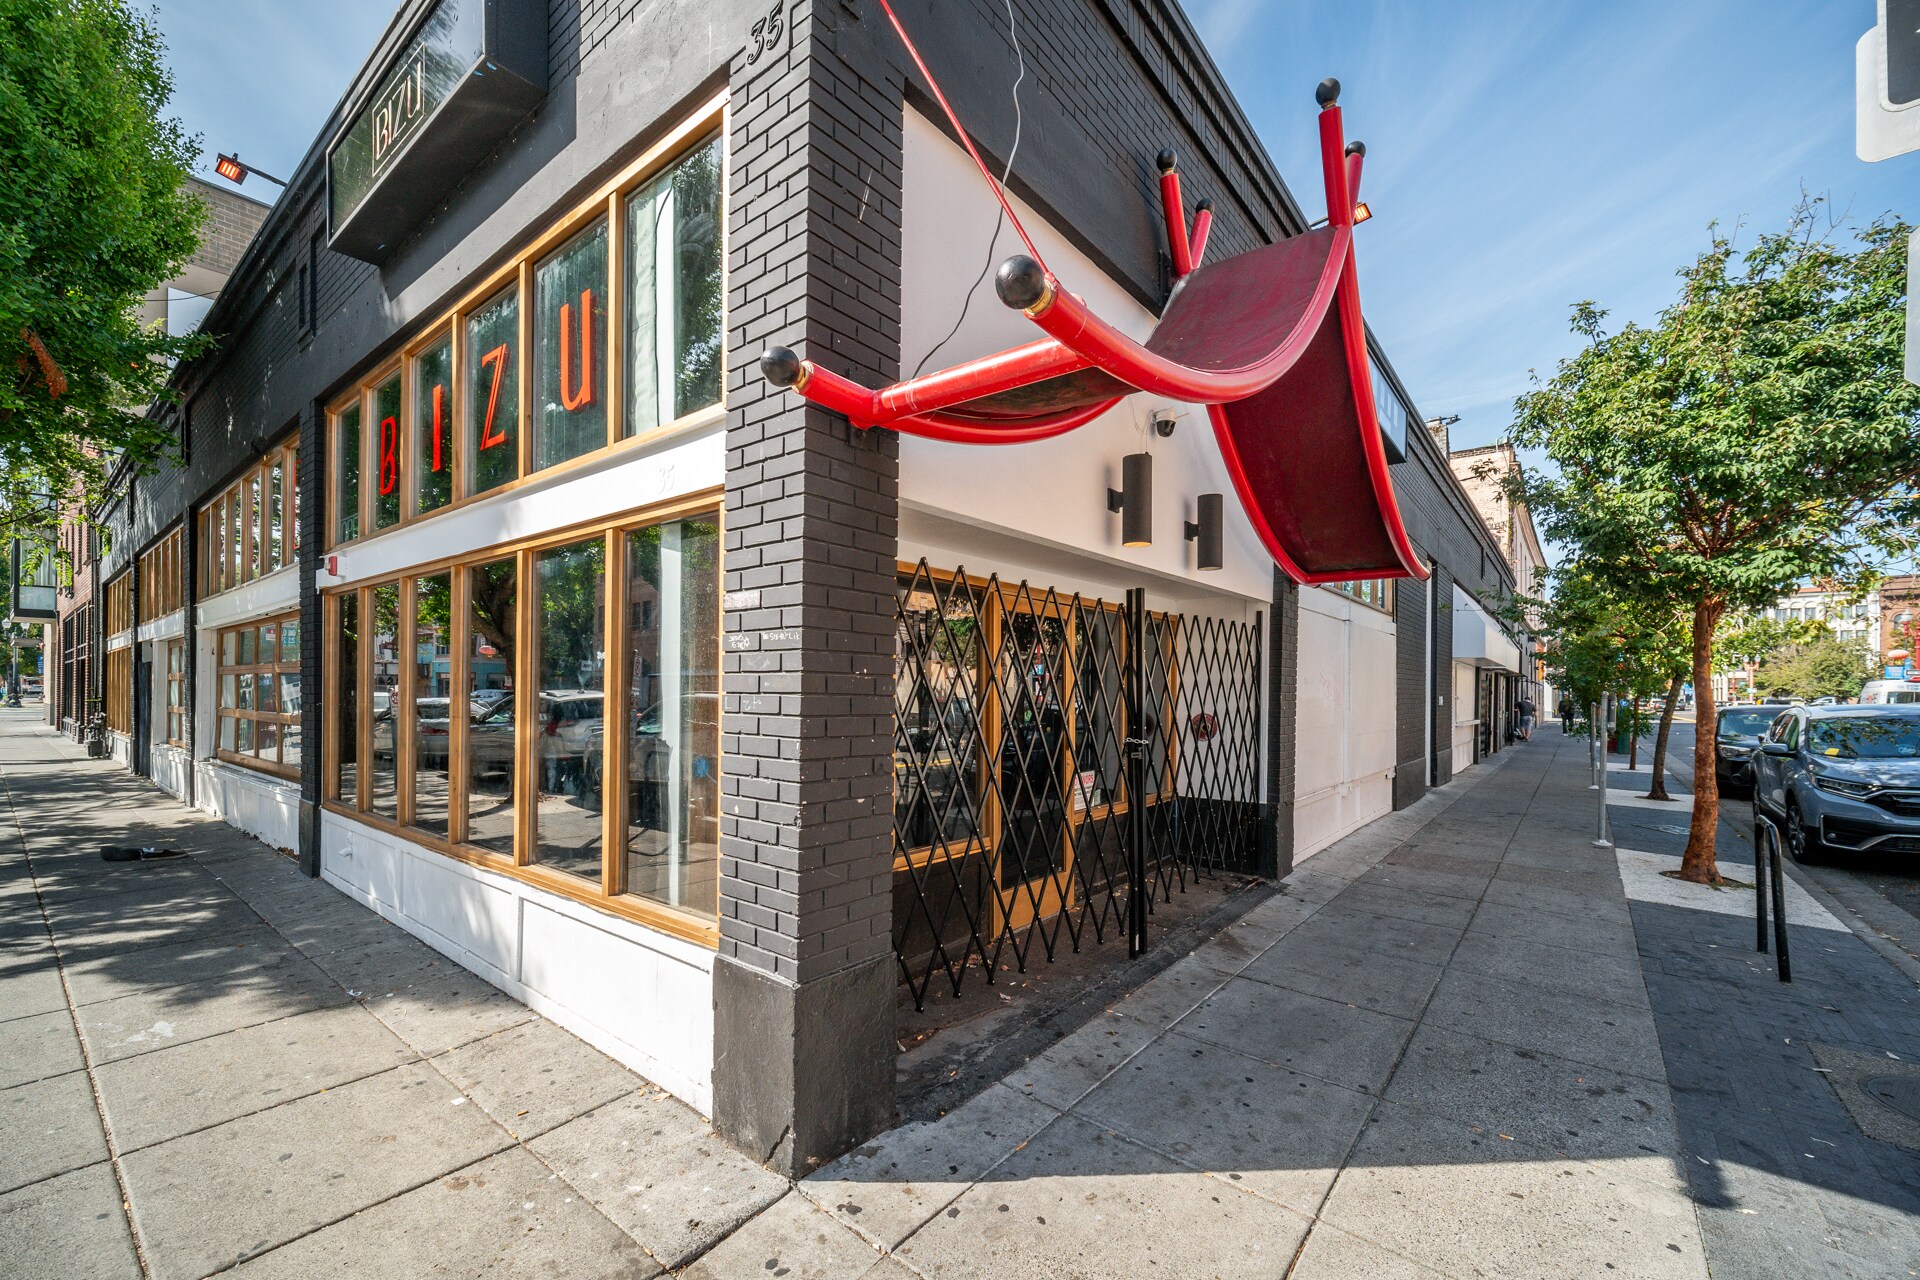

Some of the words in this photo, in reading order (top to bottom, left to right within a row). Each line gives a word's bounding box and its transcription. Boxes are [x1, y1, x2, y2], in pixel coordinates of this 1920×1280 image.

[746, 0, 784, 66] 35
[376, 60, 422, 161] BIZU
[379, 287, 591, 496] BIZU
